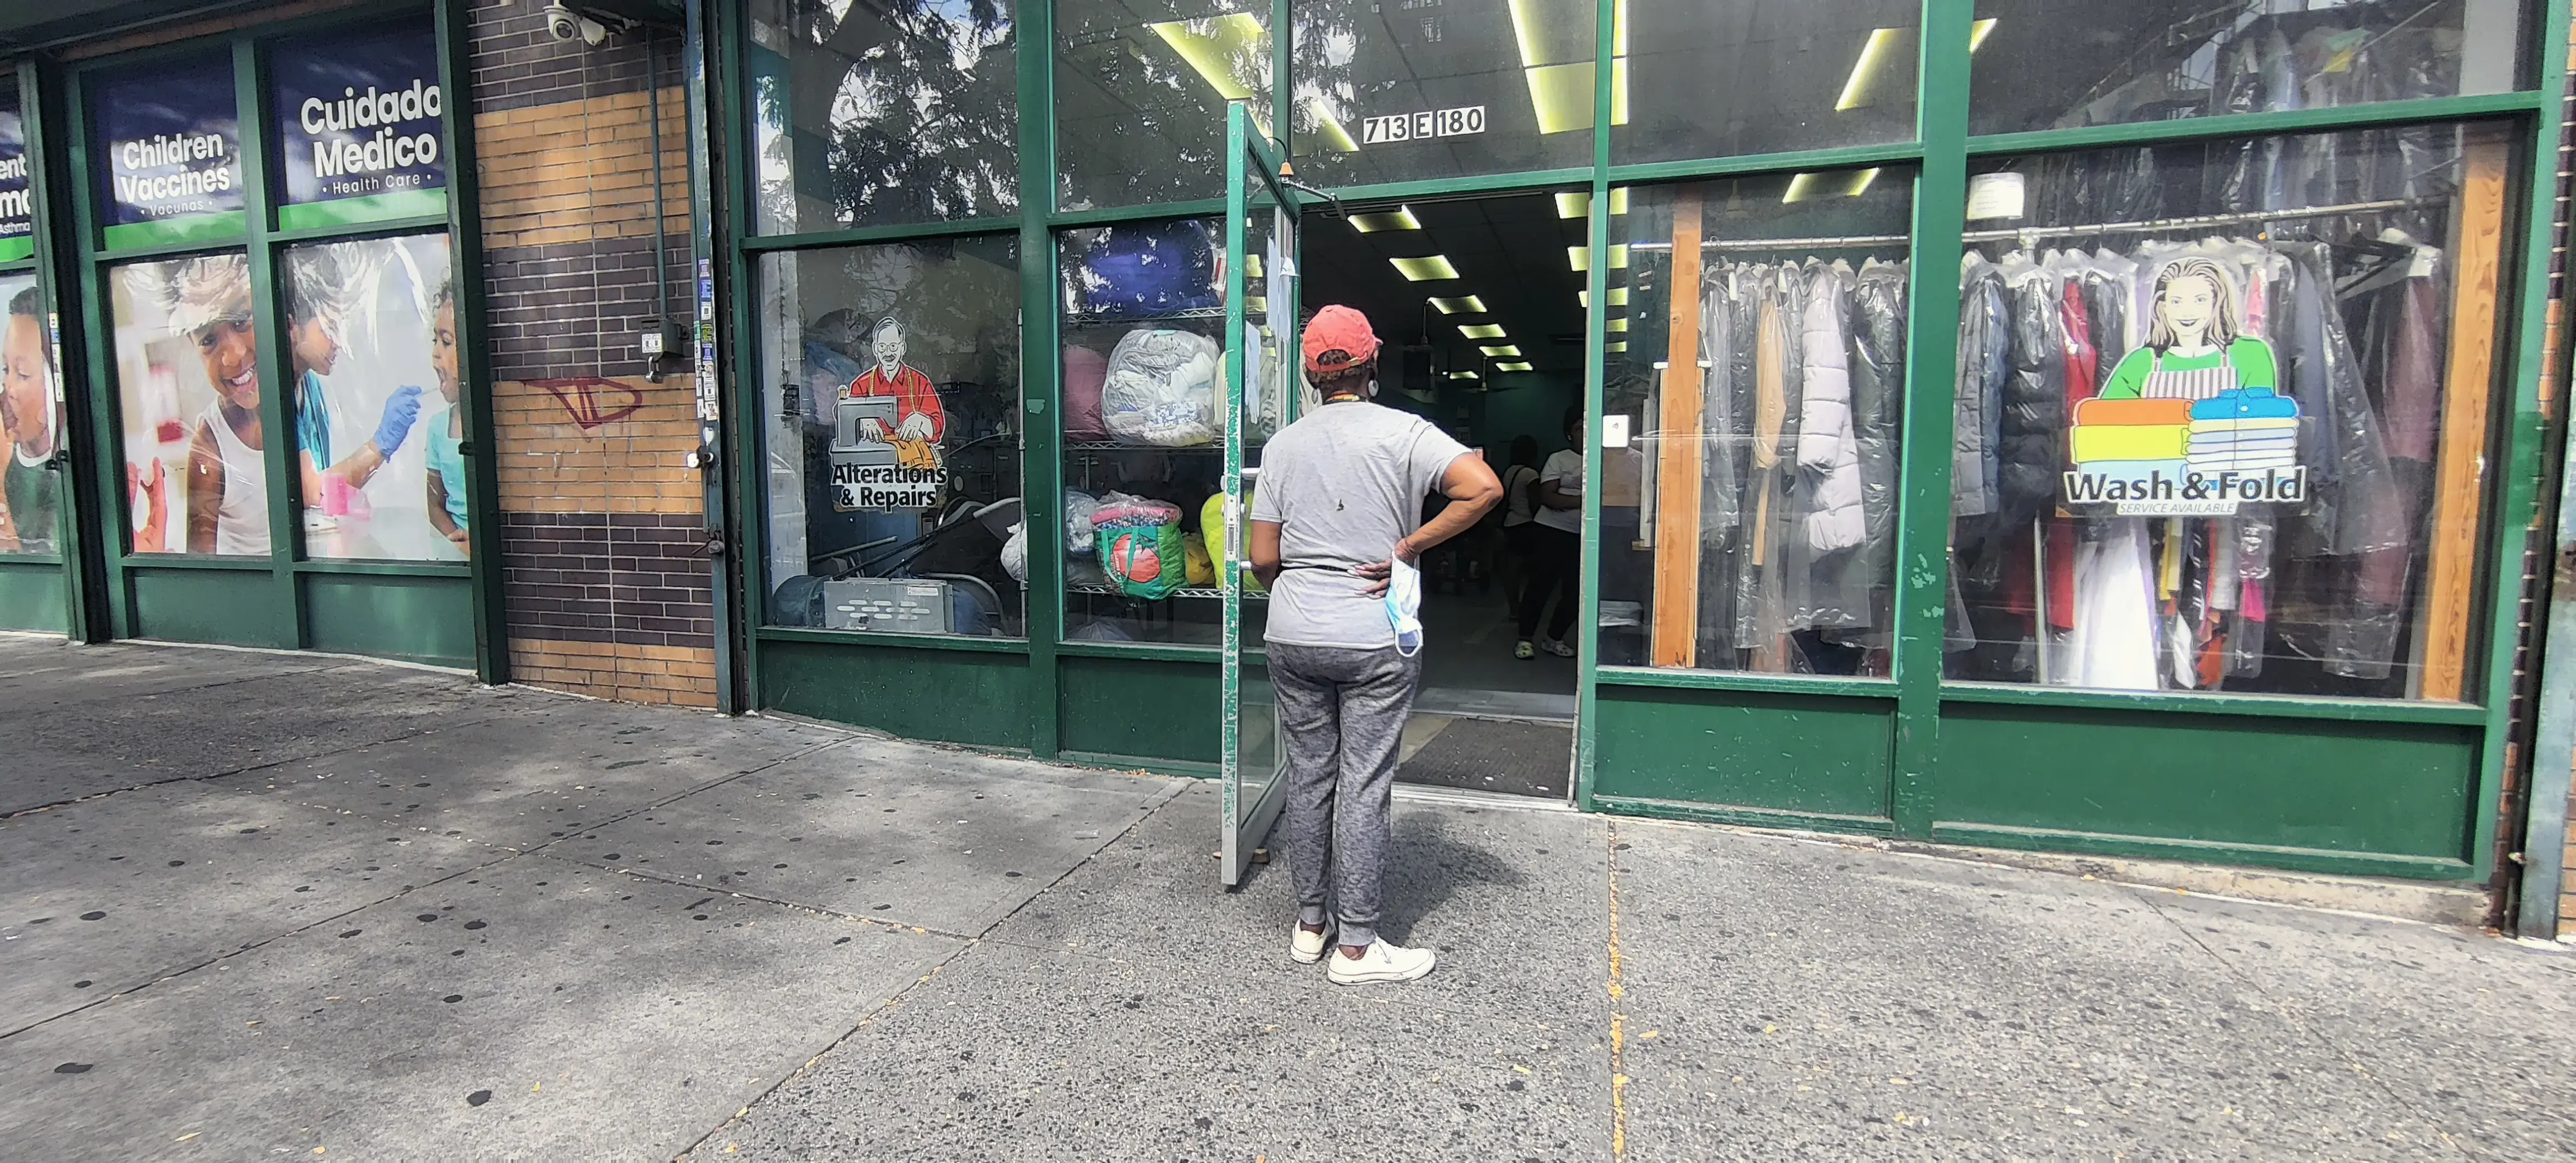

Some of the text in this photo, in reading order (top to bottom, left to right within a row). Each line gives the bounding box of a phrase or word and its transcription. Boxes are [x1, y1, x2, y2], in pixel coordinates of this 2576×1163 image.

[301, 79, 442, 135] Cuidado
[1366, 108, 1482, 142] 713 E 180
[123, 133, 224, 170] Children
[314, 126, 437, 178] Medico
[120, 164, 230, 204] Vaccines
[333, 174, 420, 195] Health Care
[150, 201, 203, 216] Vacunas
[831, 462, 947, 484] Alterations
[2068, 467, 2302, 501] Wash & Fold
[840, 485, 937, 512] & Repairs
[2120, 503, 2235, 513] SERVICE AVAILABLE
